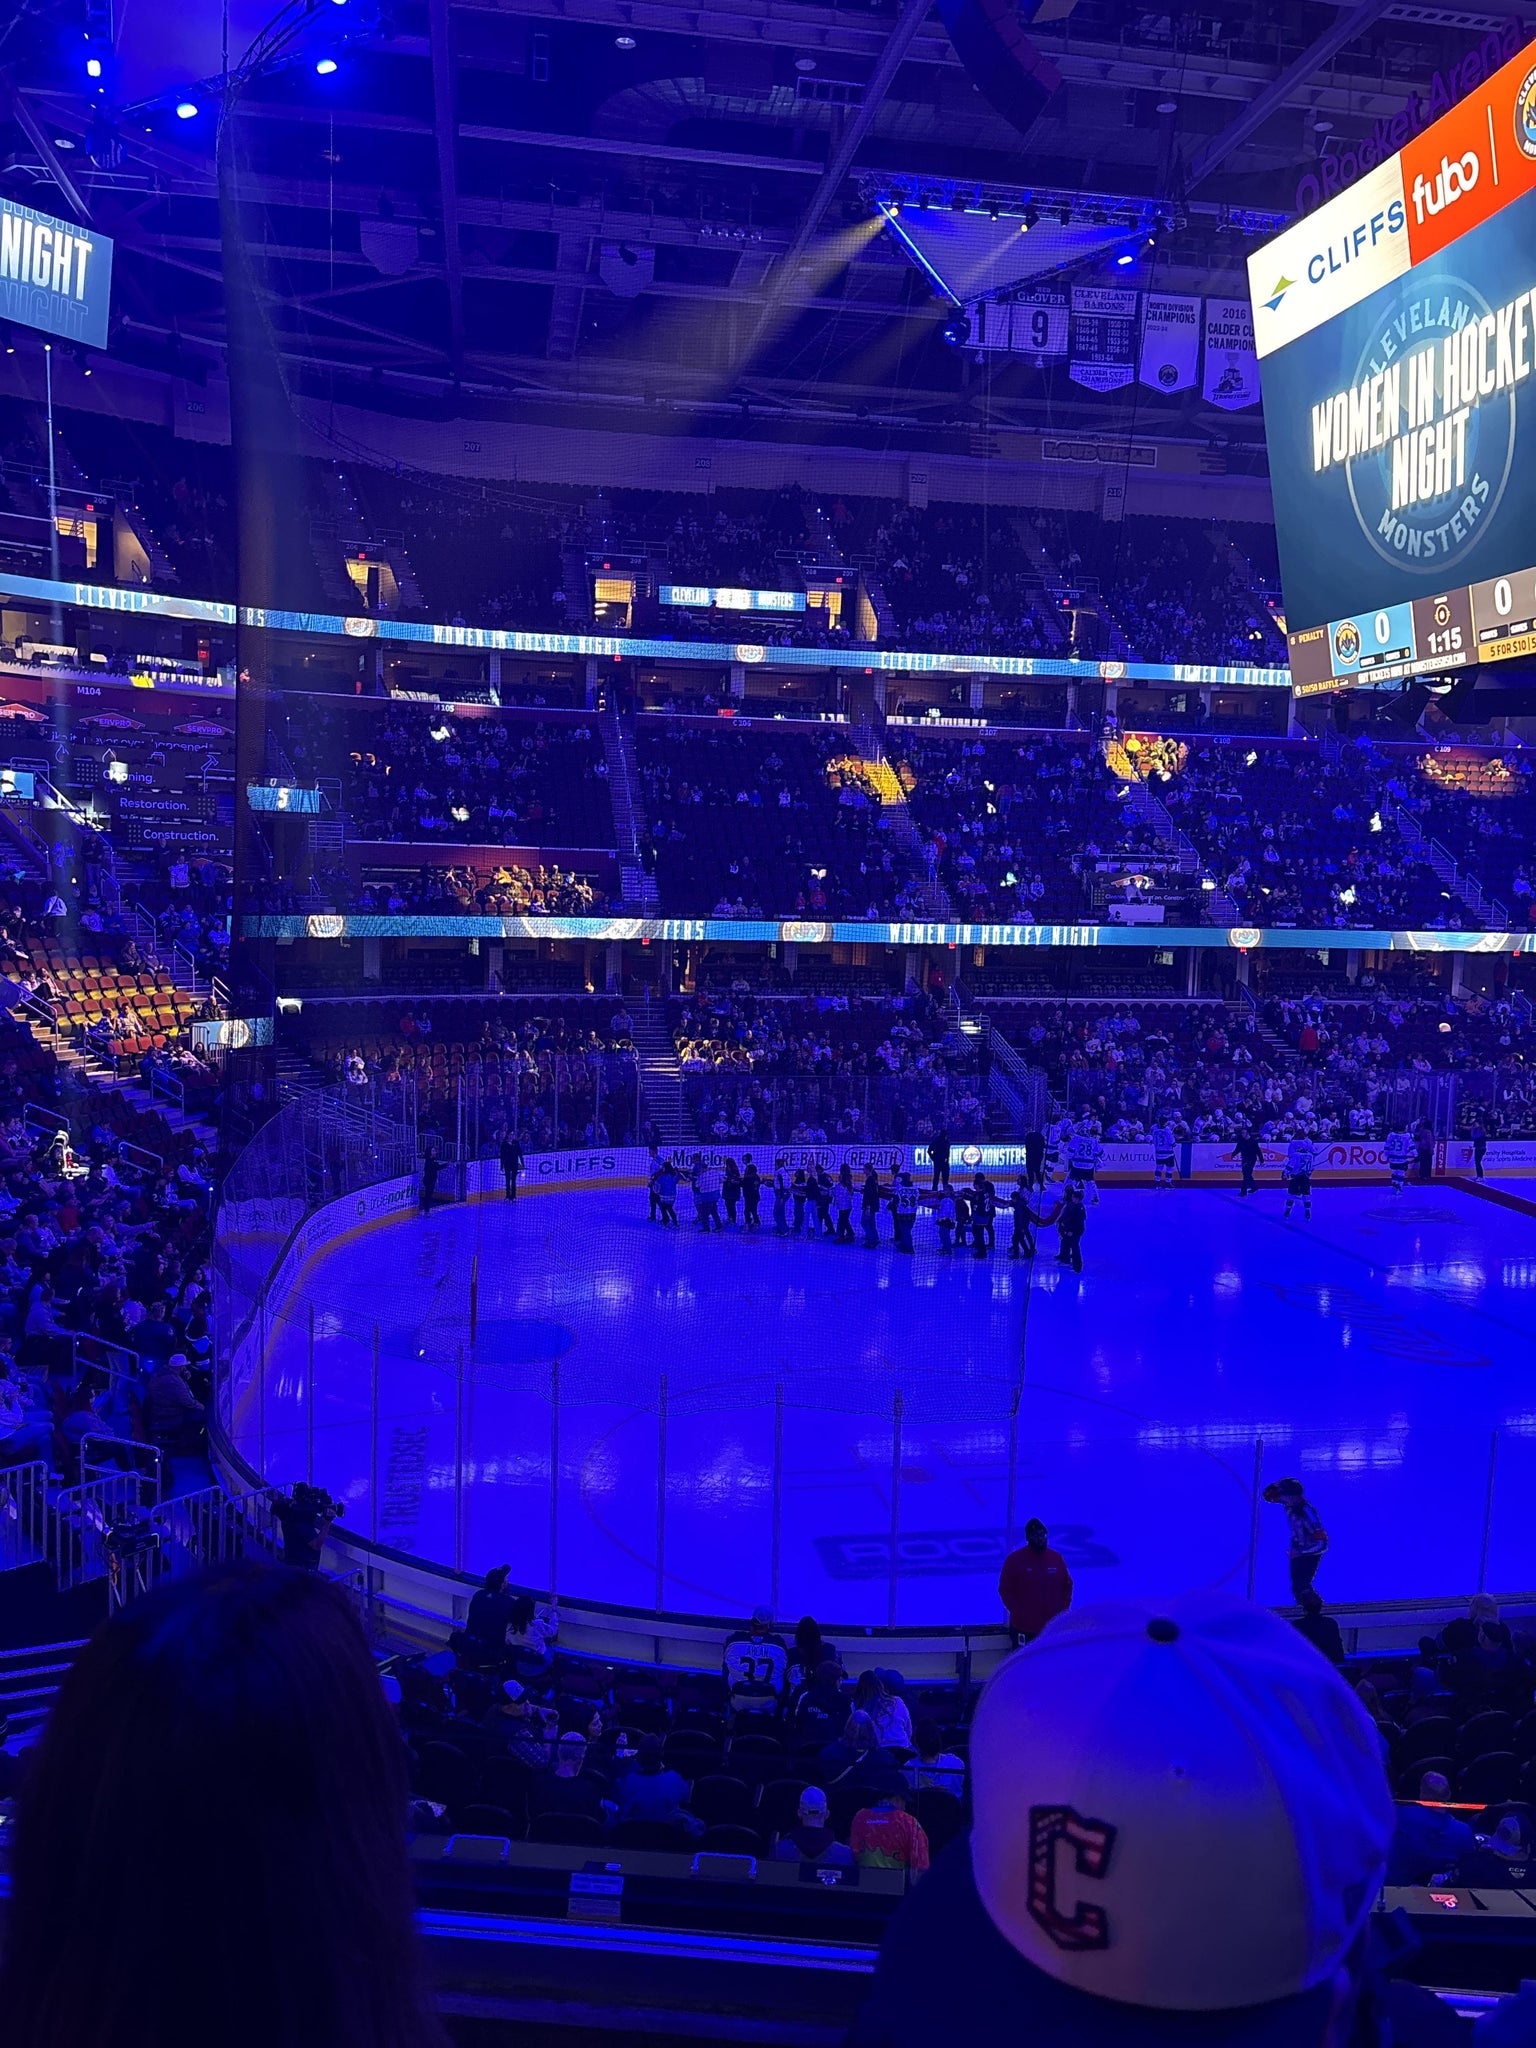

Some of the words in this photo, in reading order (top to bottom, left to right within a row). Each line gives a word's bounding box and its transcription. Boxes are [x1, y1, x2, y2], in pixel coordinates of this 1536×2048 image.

[1321, 91, 1422, 198] Rocket
[1428, 15, 1523, 121] Arena
[1411, 151, 1479, 225] fubo
[1307, 200, 1405, 284] CLIFFS
[0, 212, 93, 301] NIGHT
[1017, 290, 1066, 304] GLOVER
[1074, 289, 1136, 302] CLEVELAND
[1083, 301, 1125, 312] BARONS
[1149, 302, 1168, 311] NORTH
[1168, 303, 1194, 312] DIVISION
[1222, 307, 1246, 320] 2016
[1146, 310, 1196, 324] CHAMPIONS
[1031, 310, 1049, 348] 9
[1207, 323, 1241, 336] CALDER
[1242, 325, 1254, 337] CU
[1207, 337, 1256, 351] CHAMPION
[1364, 296, 1480, 384] LEVELAN
[187, 402, 205, 413] 206
[1310, 362, 1402, 473] WOMEN
[1407, 347, 1436, 429] IN
[1391, 407, 1470, 511] NIGHT
[1377, 472, 1490, 558] MONSTERS
[1494, 578, 1513, 616] 0
[433, 624, 484, 647] WOMEN
[1299, 629, 1324, 644] PENALTY
[1374, 611, 1391, 644] 0
[1427, 626, 1463, 654] 1:15
[1490, 648, 1496, 657] 5
[1497, 643, 1512, 655] FOR
[1513, 639, 1527, 653] $10
[1174, 664, 1218, 682] WOMEN
[1223, 667, 1238, 684] IN
[77, 686, 101, 696] M104
[1318, 679, 1340, 691] RAFFLE
[187, 725, 222, 734] SERVPRO
[102, 769, 156, 784] Cning.
[120, 798, 190, 811] Restoration.
[143, 829, 219, 841] Construction.
[889, 923, 946, 944] WOMEN
[955, 924, 972, 945] IN
[981, 924, 1043, 946] HOCKEY
[1051, 926, 1101, 946] NIGHT
[672, 1149, 722, 1168] Moelo
[981, 1147, 1027, 1166] MONSTERS
[1079, 1143, 1093, 1157] 28
[1119, 1151, 1156, 1162] MUTUA
[1232, 1153, 1276, 1162] SERO
[537, 1155, 616, 1176] CLIFFS
[739, 1656, 775, 1681] 37
[1028, 1804, 1117, 1951] C
